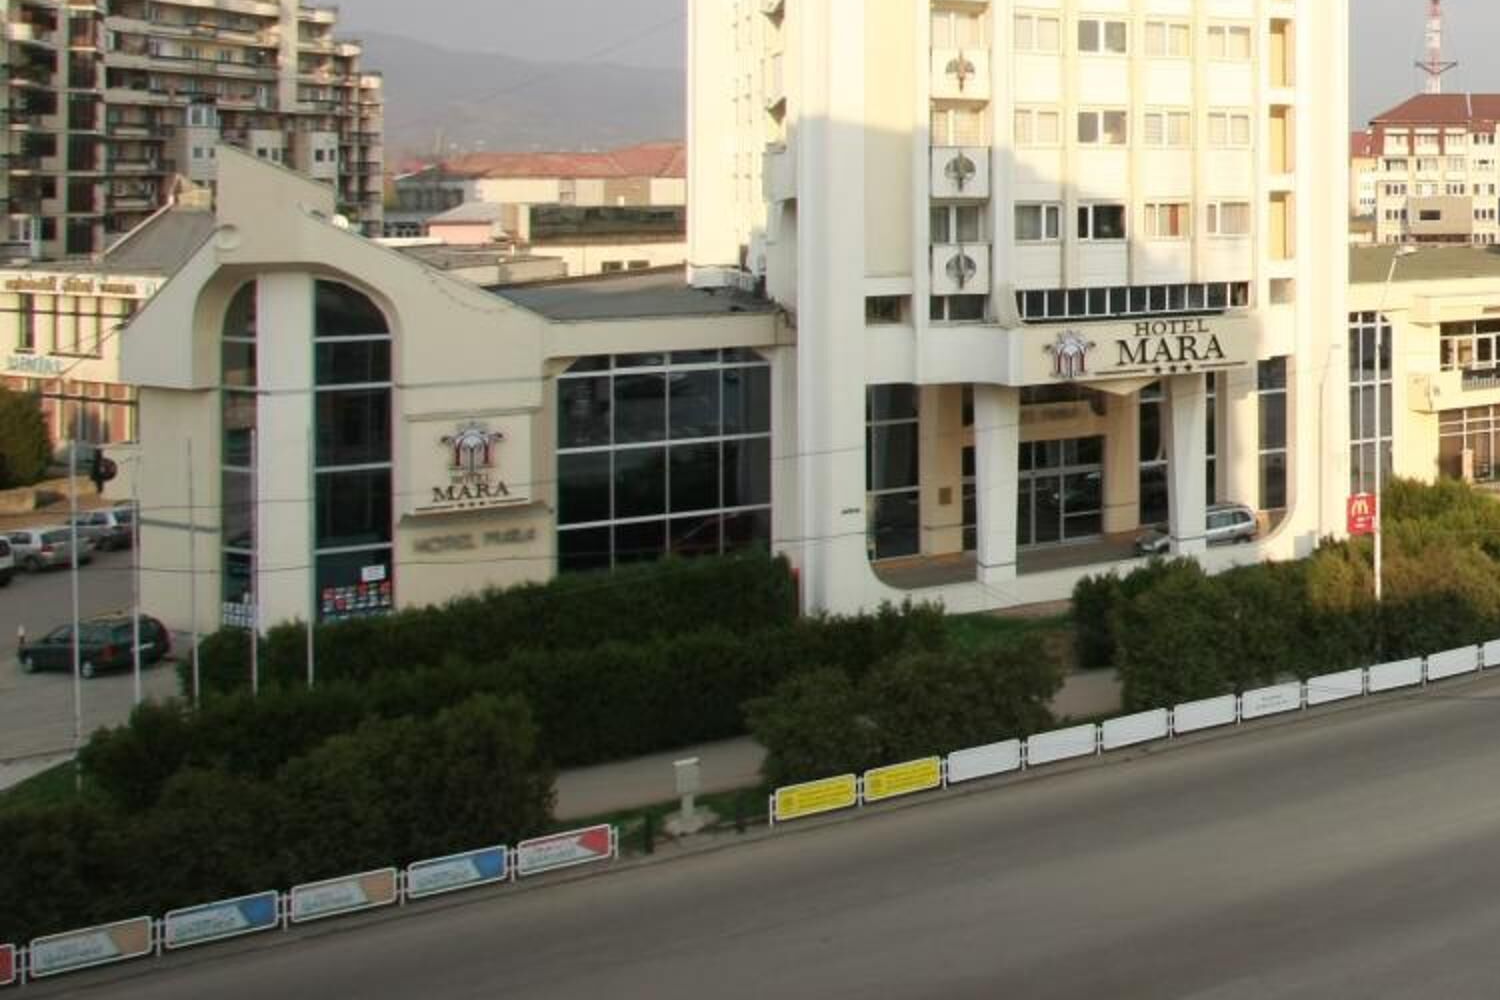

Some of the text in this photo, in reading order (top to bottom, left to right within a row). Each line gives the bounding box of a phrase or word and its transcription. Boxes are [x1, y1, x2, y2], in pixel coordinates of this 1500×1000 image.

[1135, 318, 1209, 337] HOTEL
[1116, 334, 1226, 366] MARA
[432, 481, 510, 502] MARA
